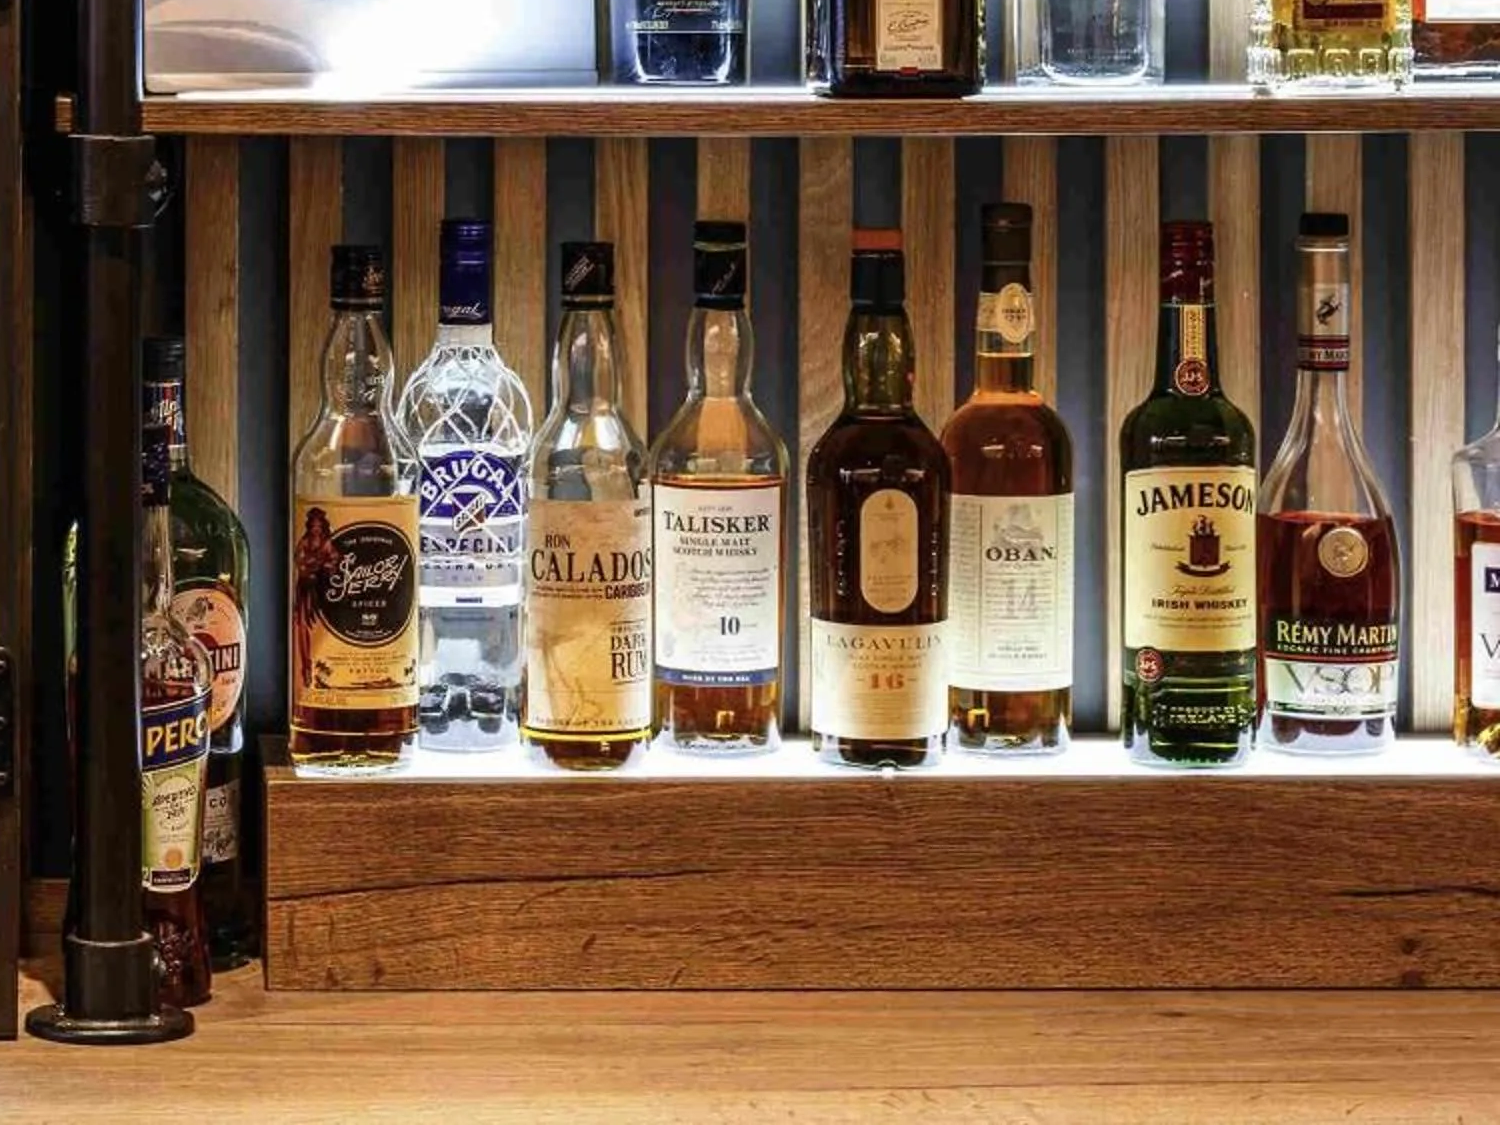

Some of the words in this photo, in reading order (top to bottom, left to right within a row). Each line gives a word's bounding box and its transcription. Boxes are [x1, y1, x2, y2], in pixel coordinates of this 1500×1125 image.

[1137, 481, 1253, 516] JAMESON
[664, 510, 770, 533] TALISKER
[420, 536, 513, 553] ESPECIAL
[545, 534, 570, 549] RON
[986, 546, 1057, 562] OBAN
[531, 548, 650, 583] CALADOS
[1151, 598, 1189, 610] IRISH
[1194, 598, 1247, 610] WHISKEY
[720, 617, 740, 635] 10
[1276, 620, 1333, 645] RÉMY
[871, 673, 905, 690] 16
